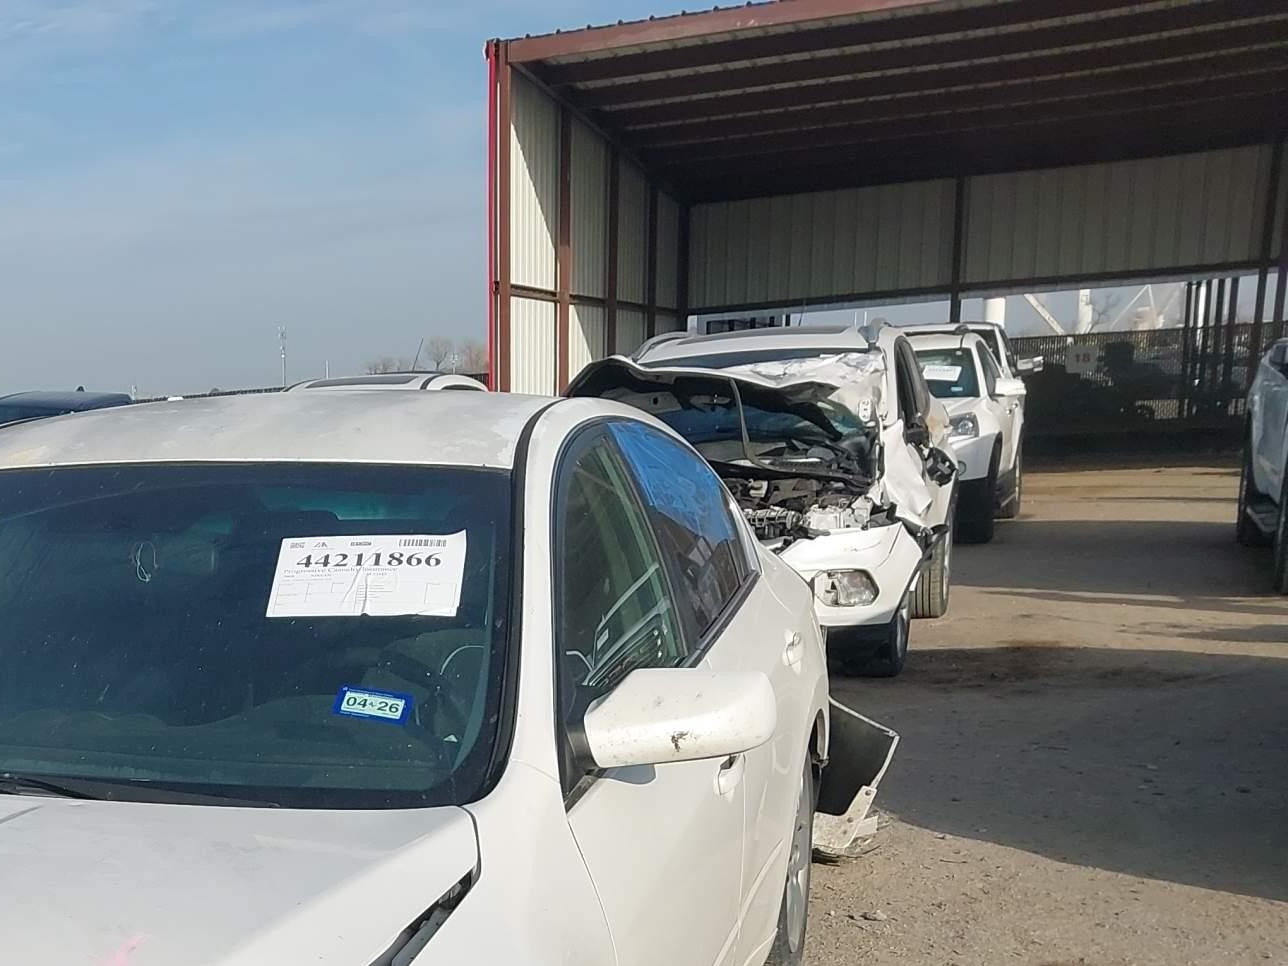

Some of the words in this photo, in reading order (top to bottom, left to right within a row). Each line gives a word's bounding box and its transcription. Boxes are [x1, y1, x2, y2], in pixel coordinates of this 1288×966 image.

[296, 551, 442, 568] 44211866
[346, 696, 368, 708] 04
[376, 701, 400, 713] 26
